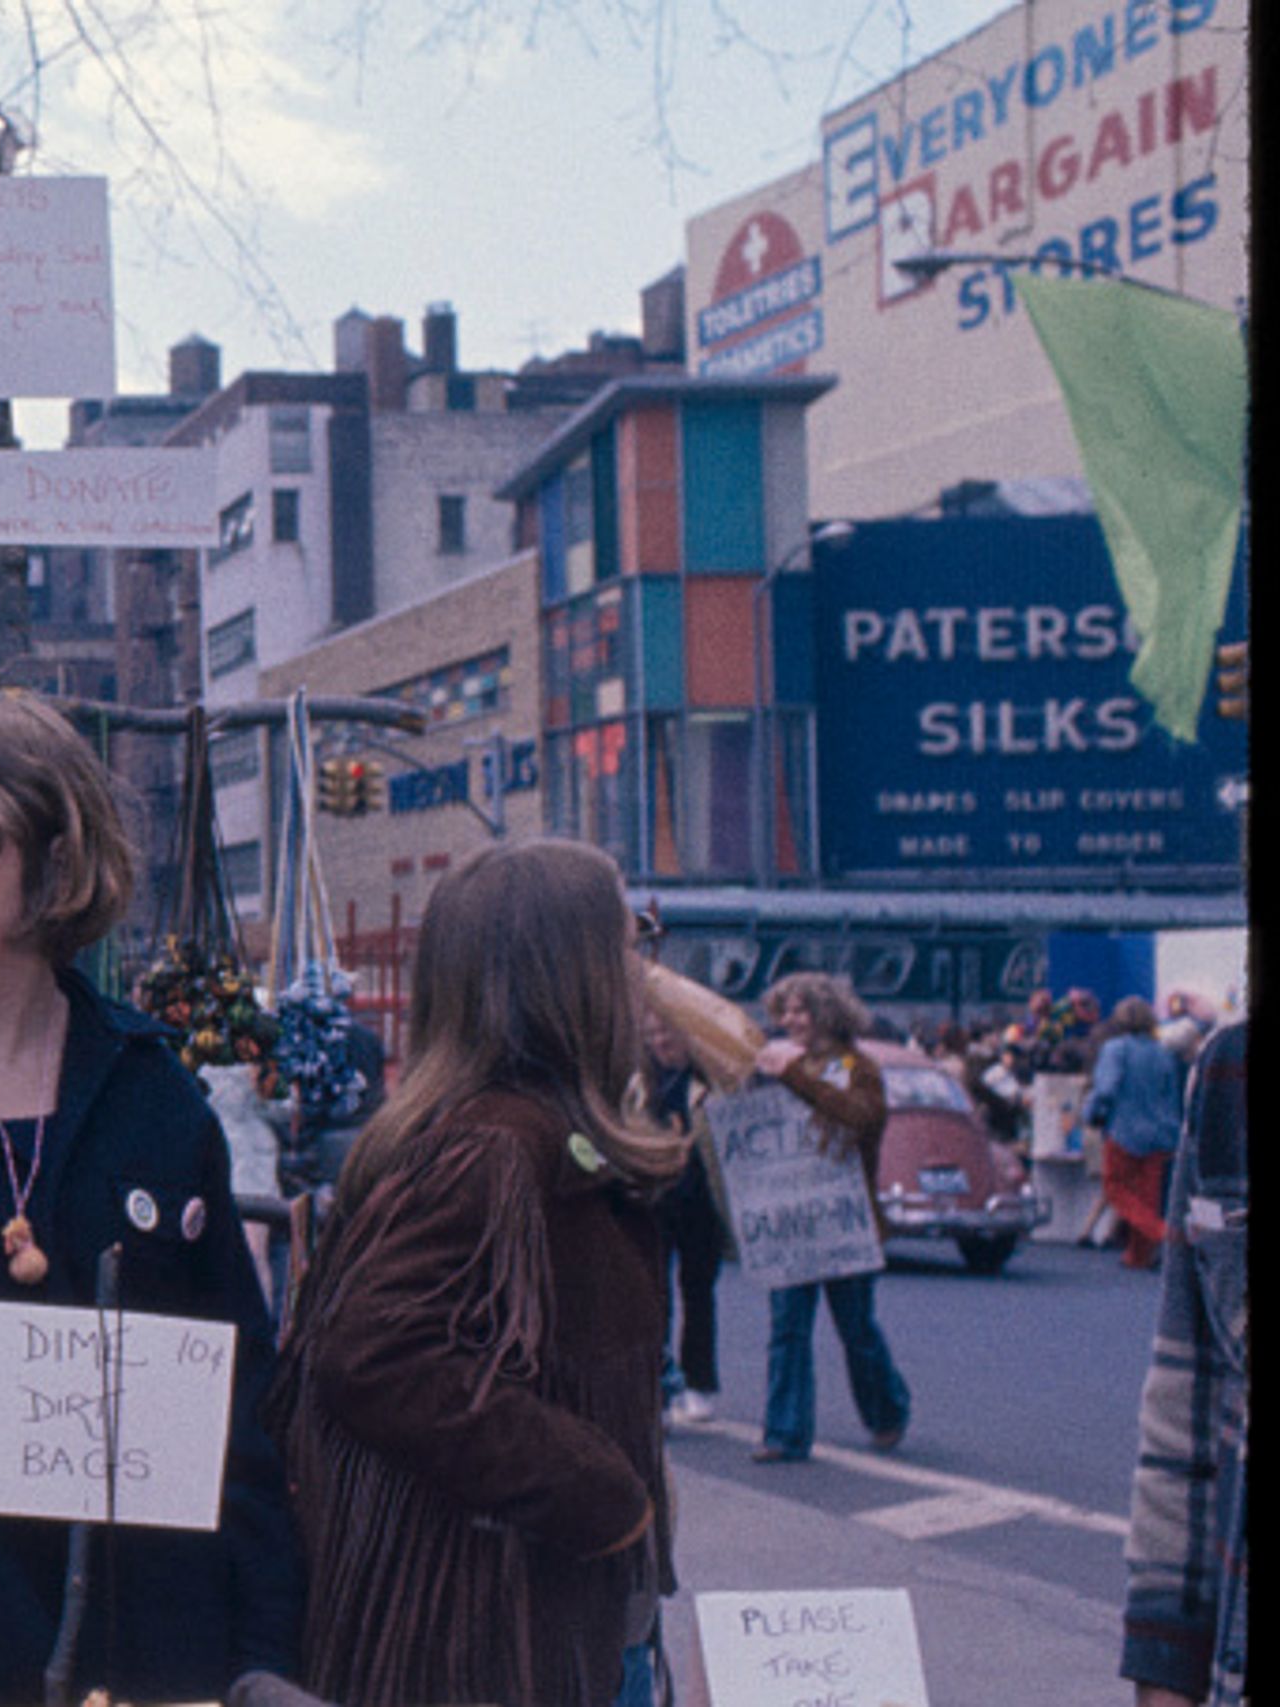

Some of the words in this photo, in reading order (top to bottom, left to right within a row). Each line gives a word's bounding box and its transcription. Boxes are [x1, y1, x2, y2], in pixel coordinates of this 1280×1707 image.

[26, 463, 172, 502] DONATE
[845, 606, 1140, 662] PATERS
[917, 698, 1141, 755] SILKS
[877, 789, 976, 813] DRAPES
[1004, 787, 1066, 811] SLIP
[1079, 787, 1184, 812] COVERS
[900, 834, 969, 857] MADE
[1007, 833, 1041, 856] TO
[1077, 831, 1163, 855] ORDER
[22, 1321, 148, 1370] DIME
[18, 1384, 125, 1442] DIRT
[22, 1443, 151, 1481] BAGS
[741, 1601, 867, 1637] PLEASE
[765, 1648, 851, 1685] TAKE
